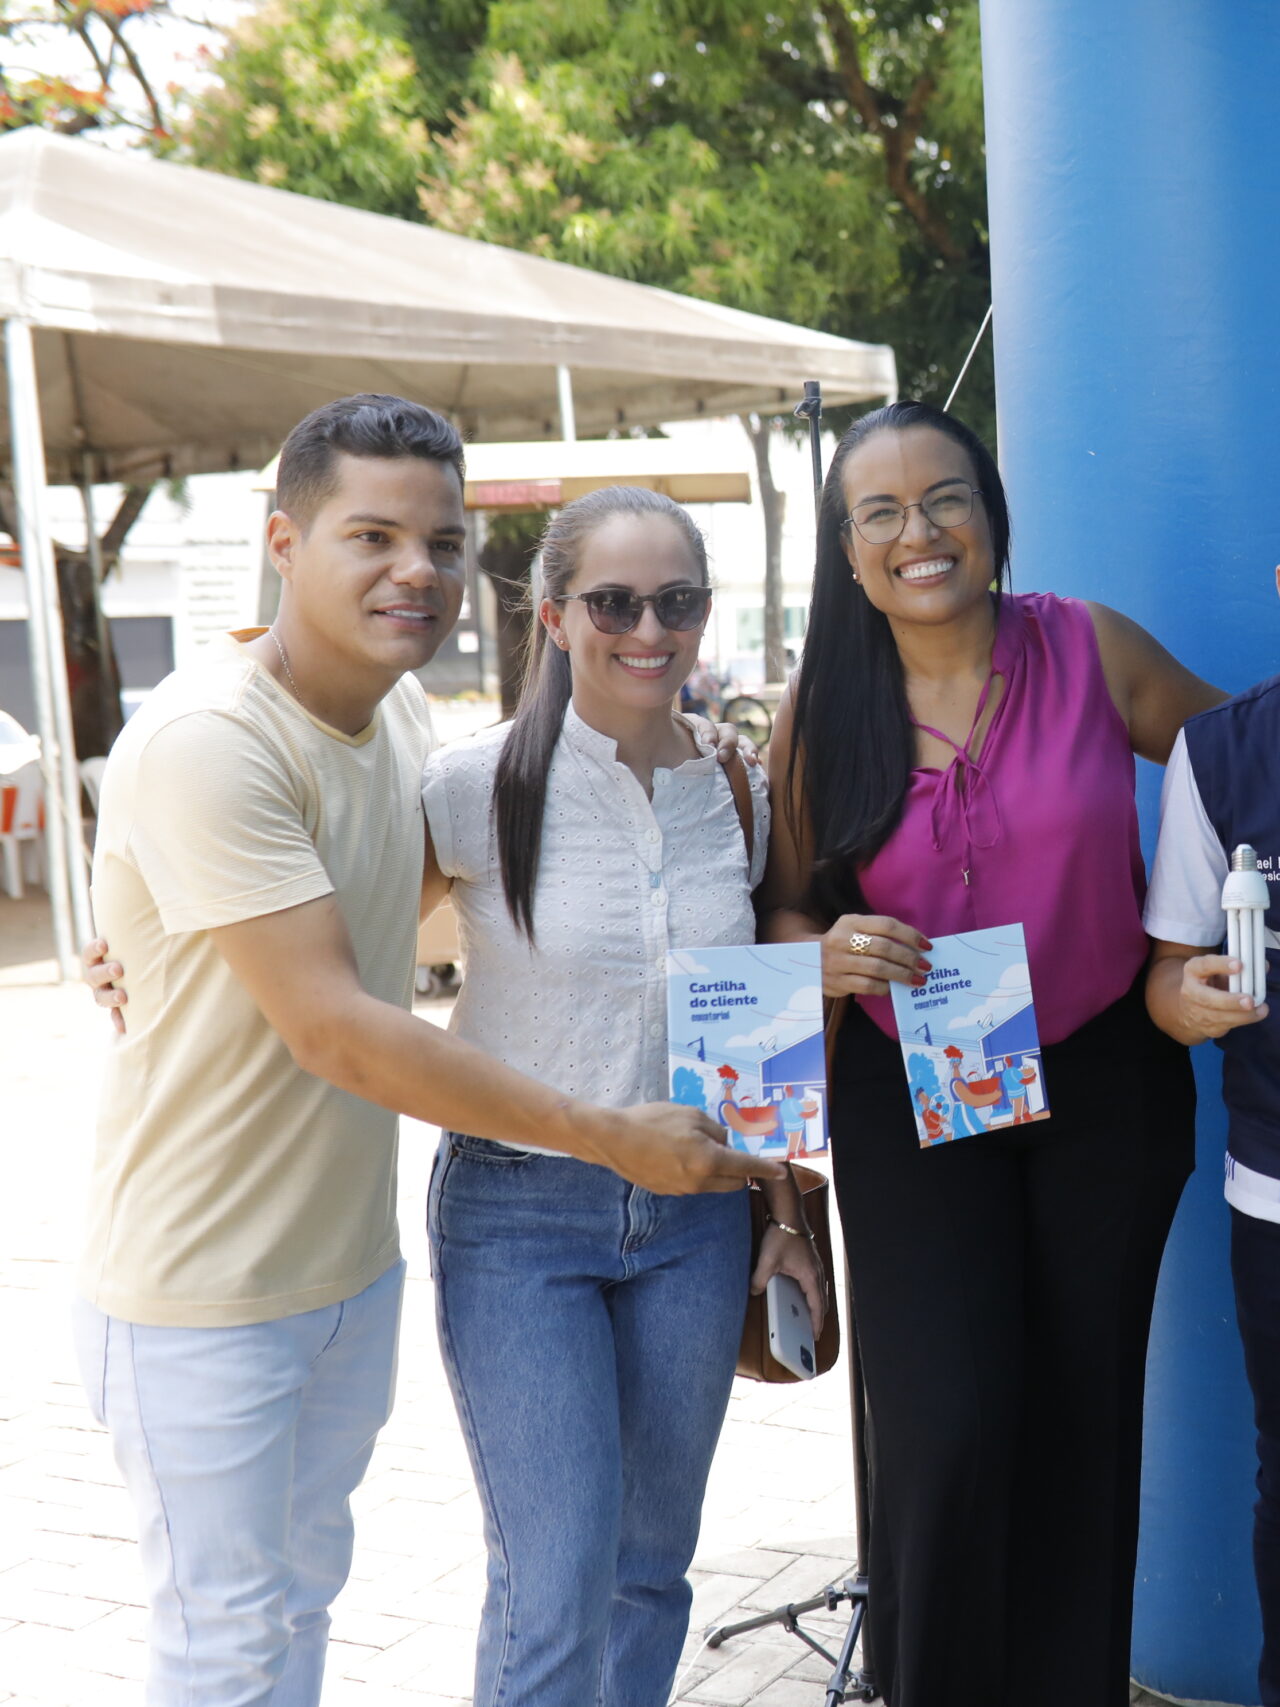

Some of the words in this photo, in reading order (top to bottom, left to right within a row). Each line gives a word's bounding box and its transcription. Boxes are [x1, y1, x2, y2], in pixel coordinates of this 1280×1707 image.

[924, 968, 960, 981] rtilha
[689, 981, 747, 993] Cartilha
[911, 987, 927, 998] do
[929, 979, 972, 994] cliente
[690, 997, 708, 1008] do
[711, 995, 758, 1007] cliente
